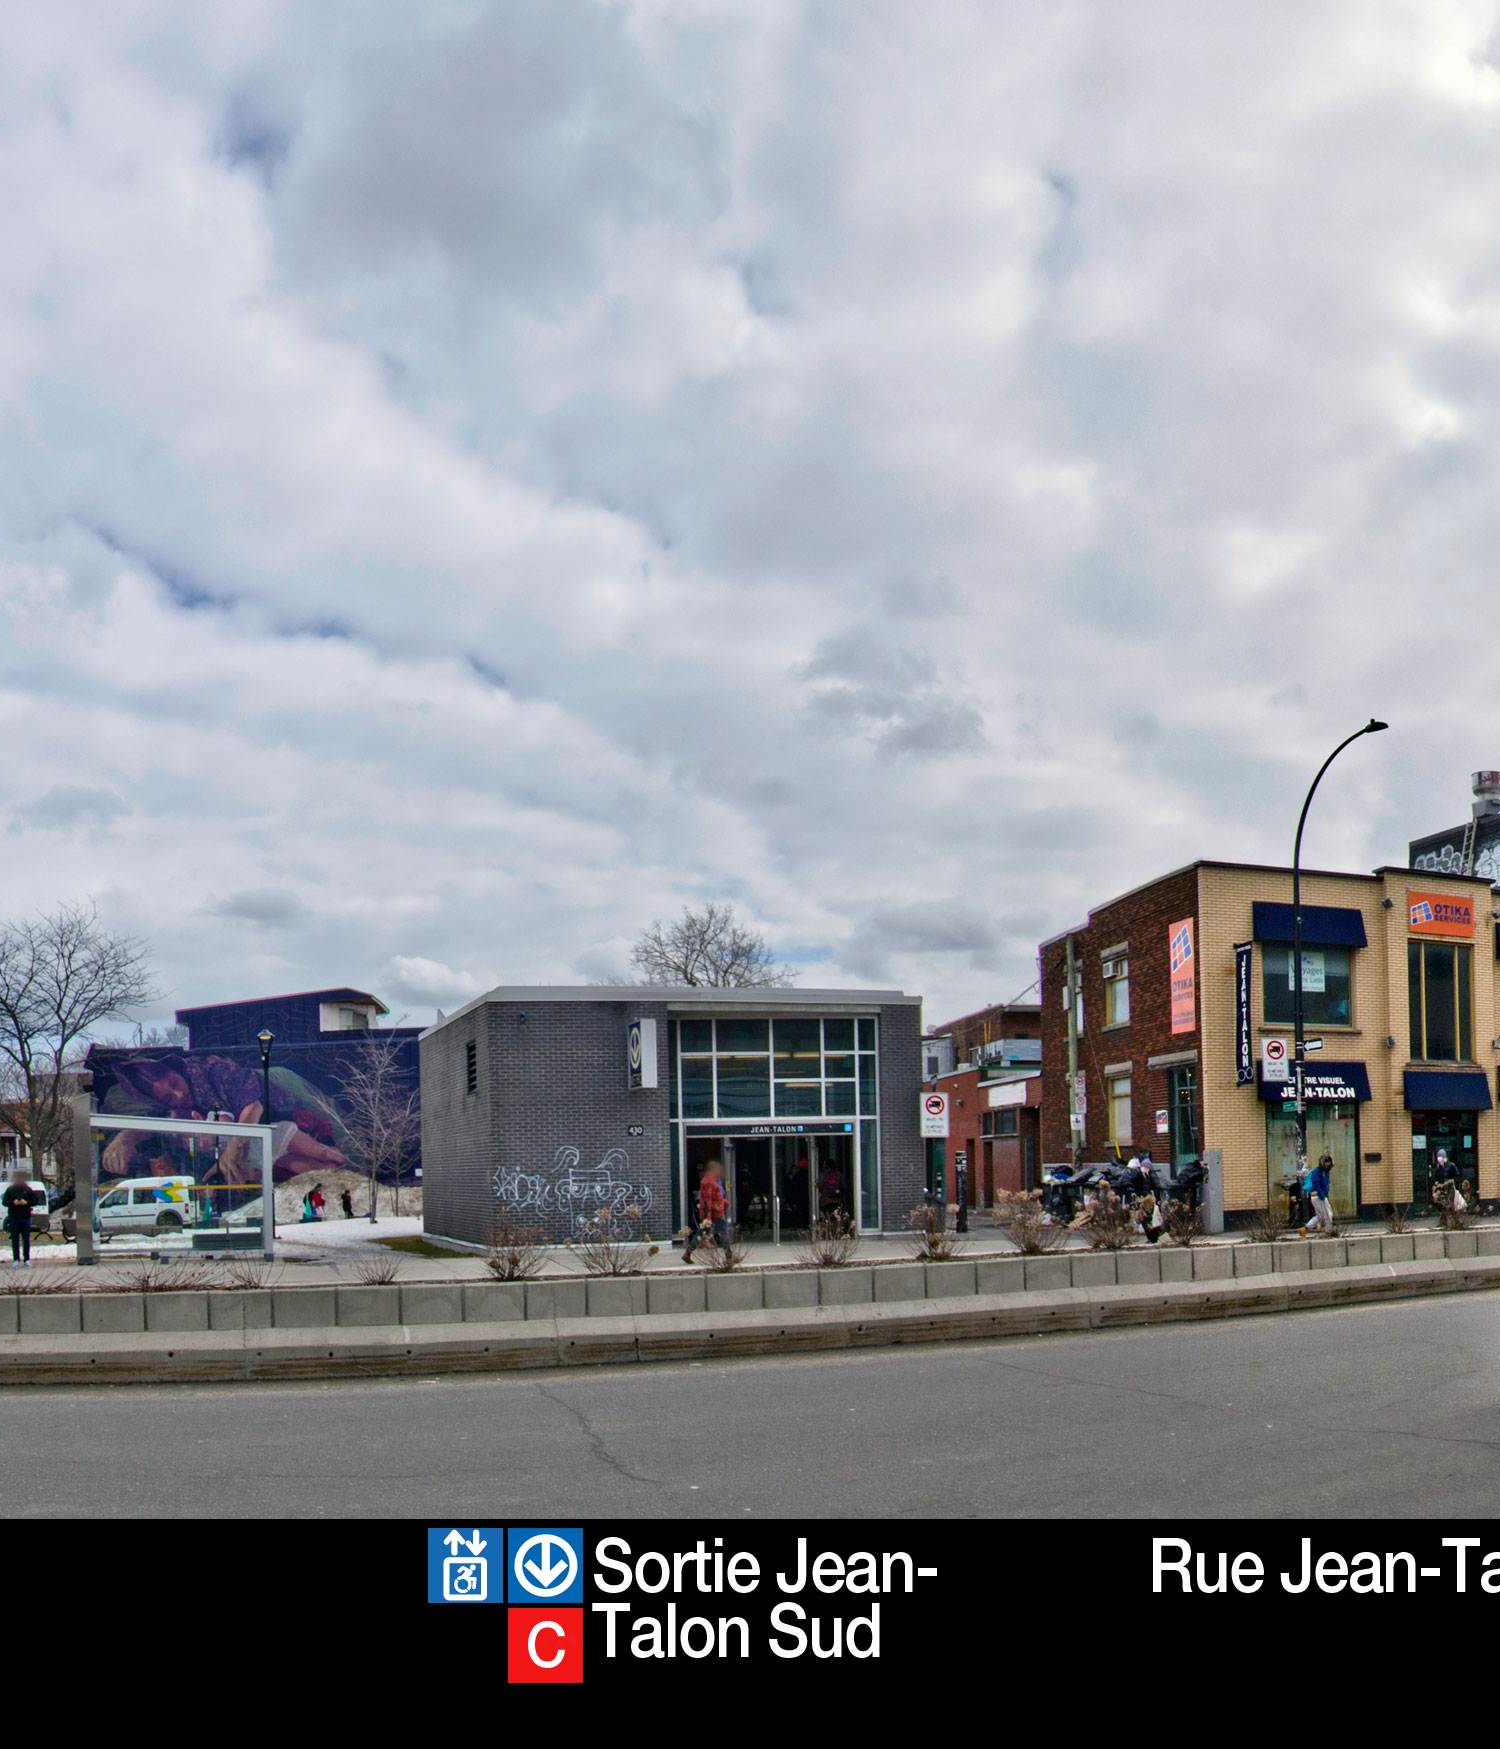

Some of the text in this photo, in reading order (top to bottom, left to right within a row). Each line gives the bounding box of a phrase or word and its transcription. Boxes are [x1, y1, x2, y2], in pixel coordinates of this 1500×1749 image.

[1434, 903, 1471, 917] OTIKA
[1434, 914, 1471, 925] SERVICES
[1290, 964, 1323, 976] Vyages
[1173, 977, 1193, 992] OTIKA
[1288, 1077, 1345, 1085] CETRE VISUEL
[1281, 1087, 1356, 1098] JEN-TALON
[629, 1126, 643, 1135] 430
